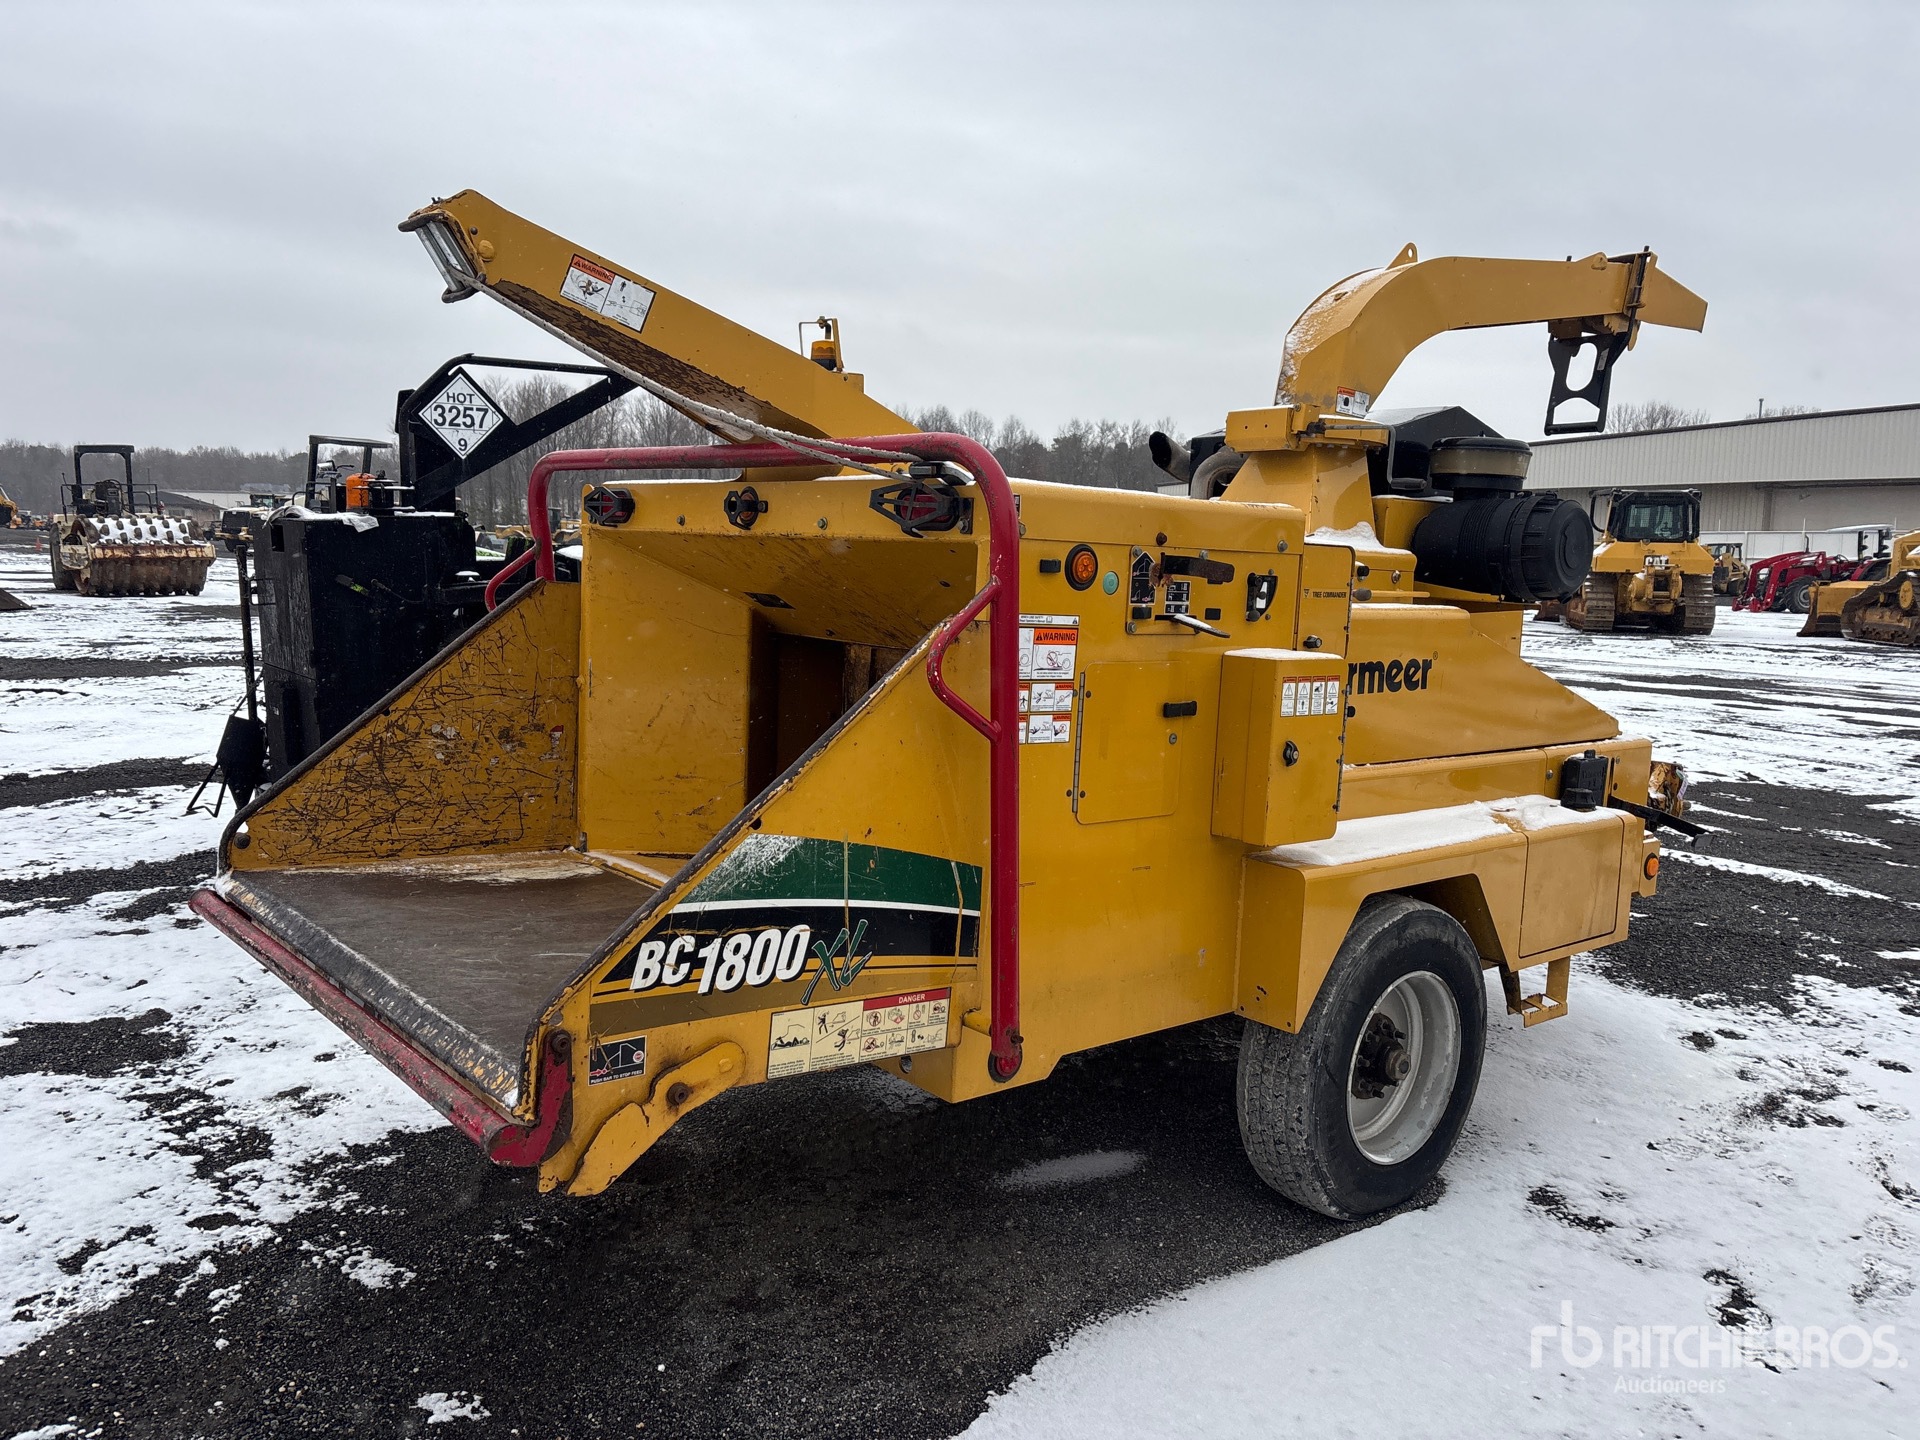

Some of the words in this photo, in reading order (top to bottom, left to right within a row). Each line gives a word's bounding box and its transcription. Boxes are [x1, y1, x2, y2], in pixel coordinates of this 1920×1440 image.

[580, 263, 613, 282] WARNING
[446, 392, 475, 404] HOT
[433, 405, 489, 429] 3257
[458, 438, 467, 451] 9
[1645, 556, 1668, 566] CAT
[1042, 632, 1076, 642] WARNING
[898, 994, 926, 1004] DANGER
